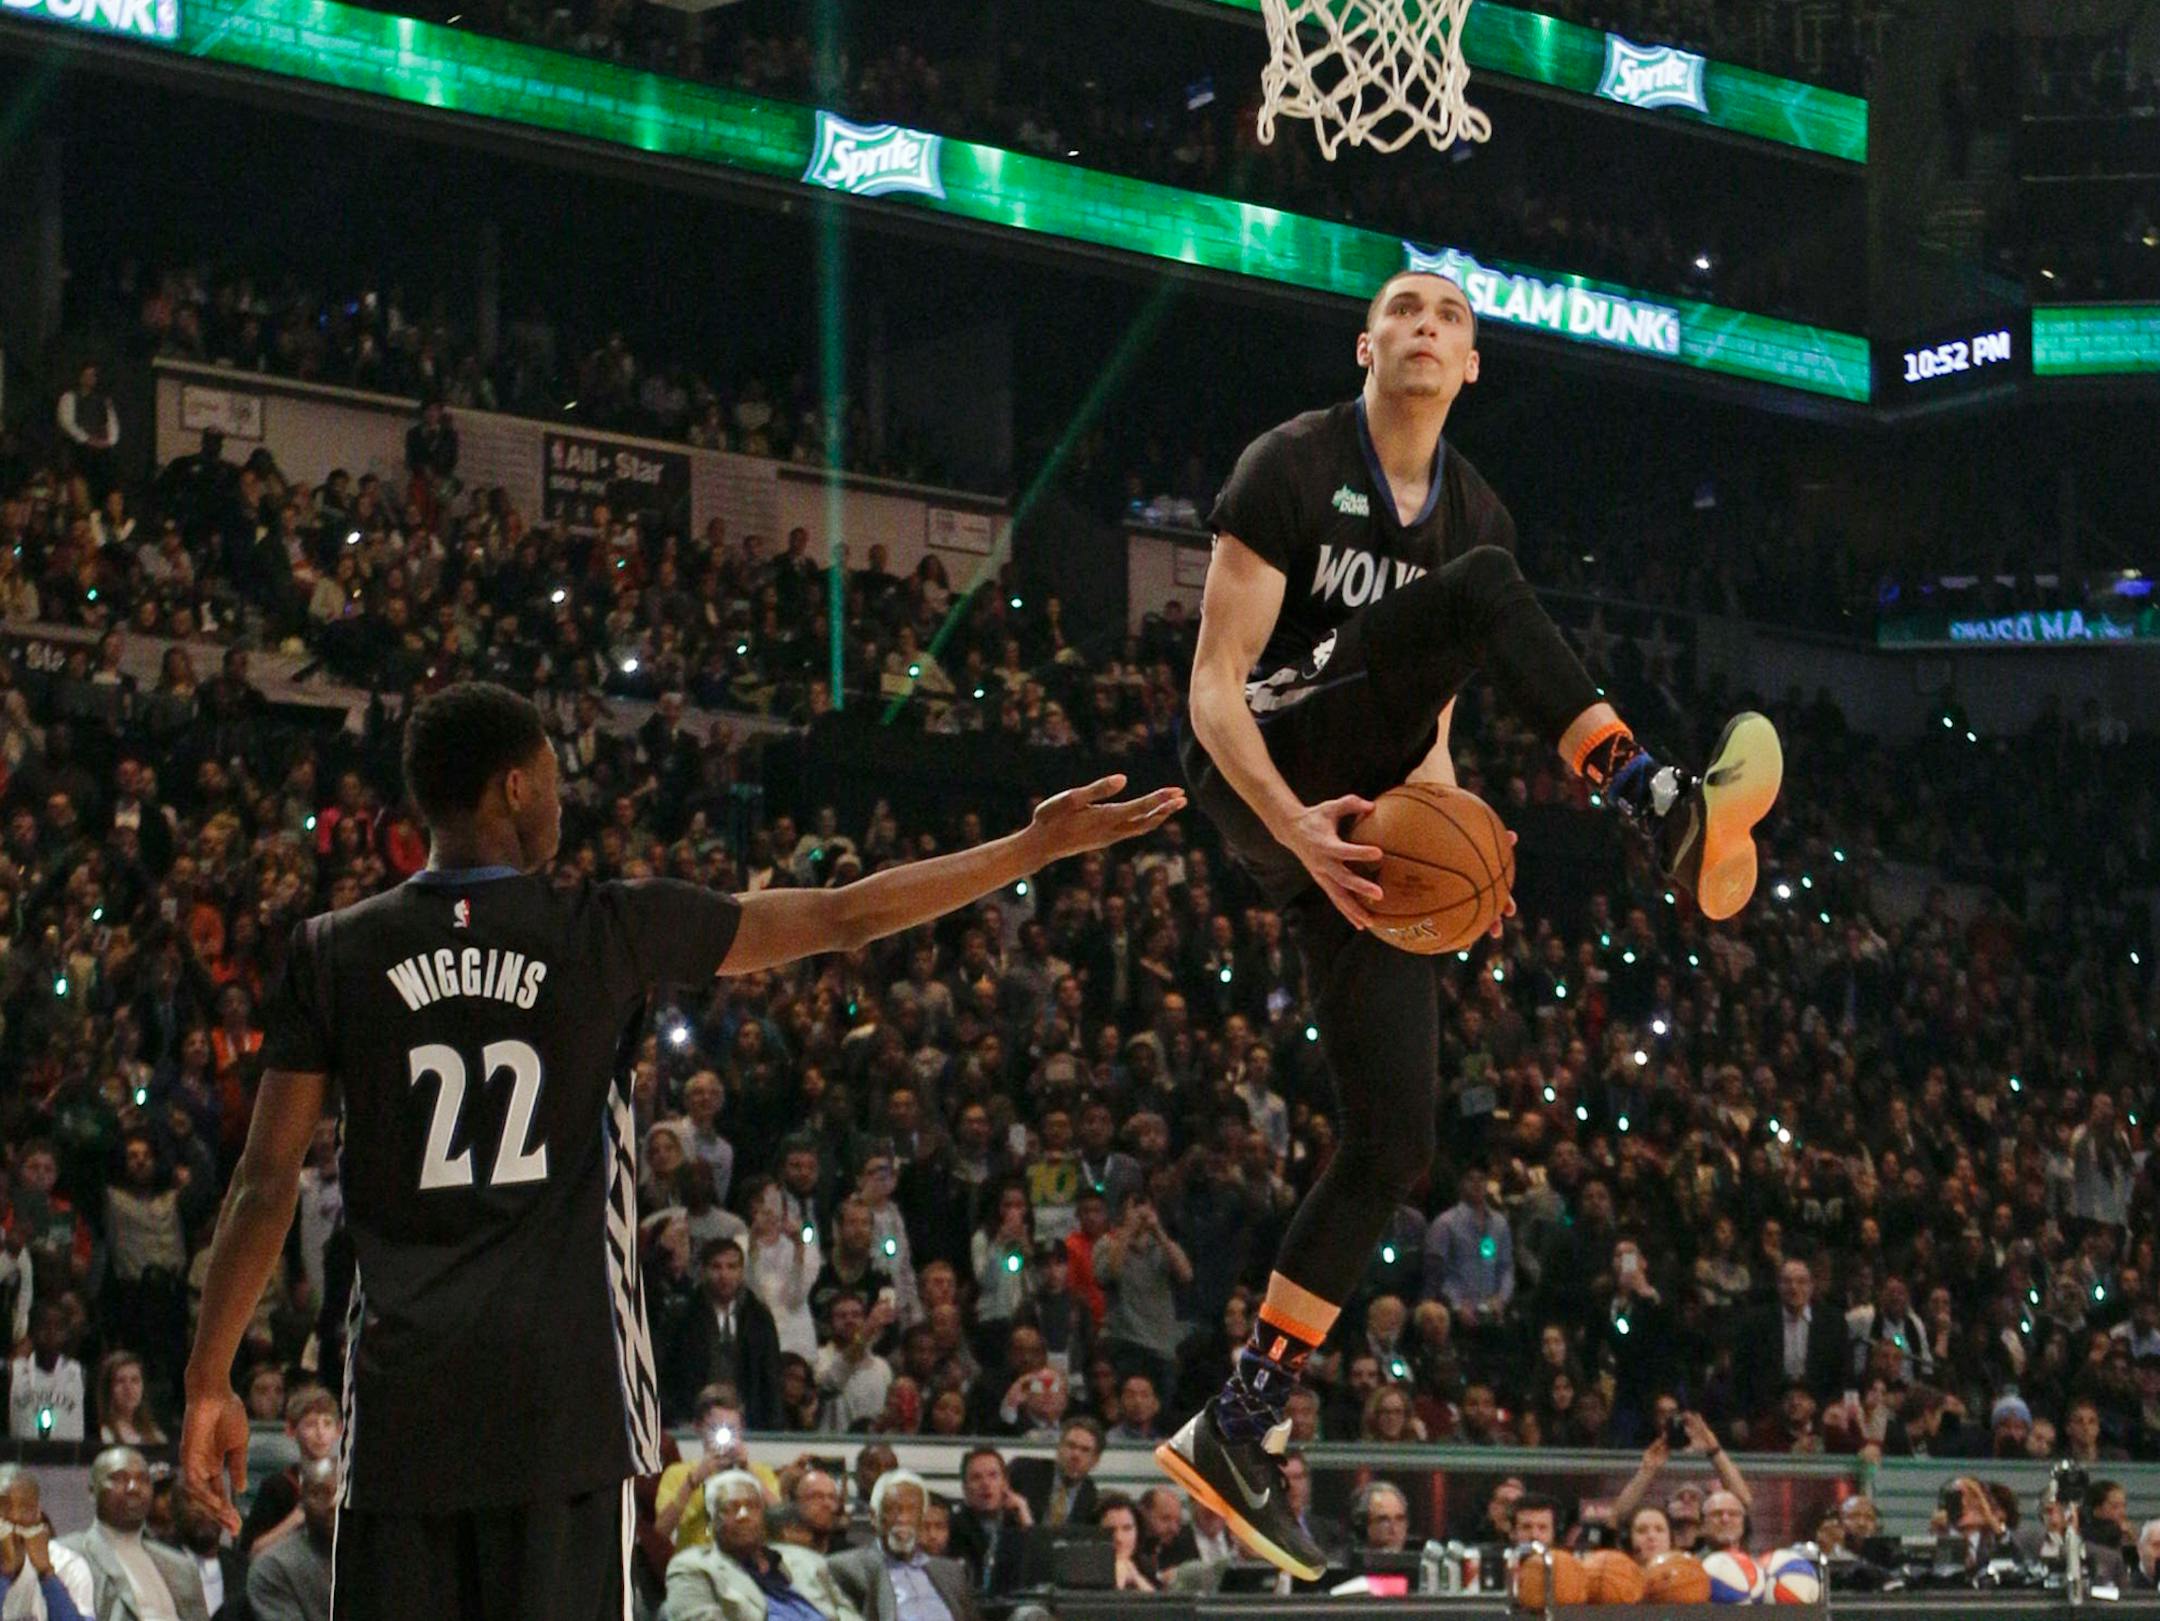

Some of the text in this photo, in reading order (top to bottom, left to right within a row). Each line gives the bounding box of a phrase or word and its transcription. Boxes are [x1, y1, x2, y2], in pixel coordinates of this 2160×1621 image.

[1, 0, 157, 36] NK
[1614, 51, 1688, 101] Sprite
[826, 128, 920, 188] Sprite
[1465, 272, 1562, 330] SLAM
[1568, 287, 1668, 350] DUNK
[1903, 331, 2011, 382] 10:52 PM
[1310, 543, 1428, 608] WOLV
[386, 947, 547, 1012] WIGGINS
[409, 1039, 547, 1190] 22
